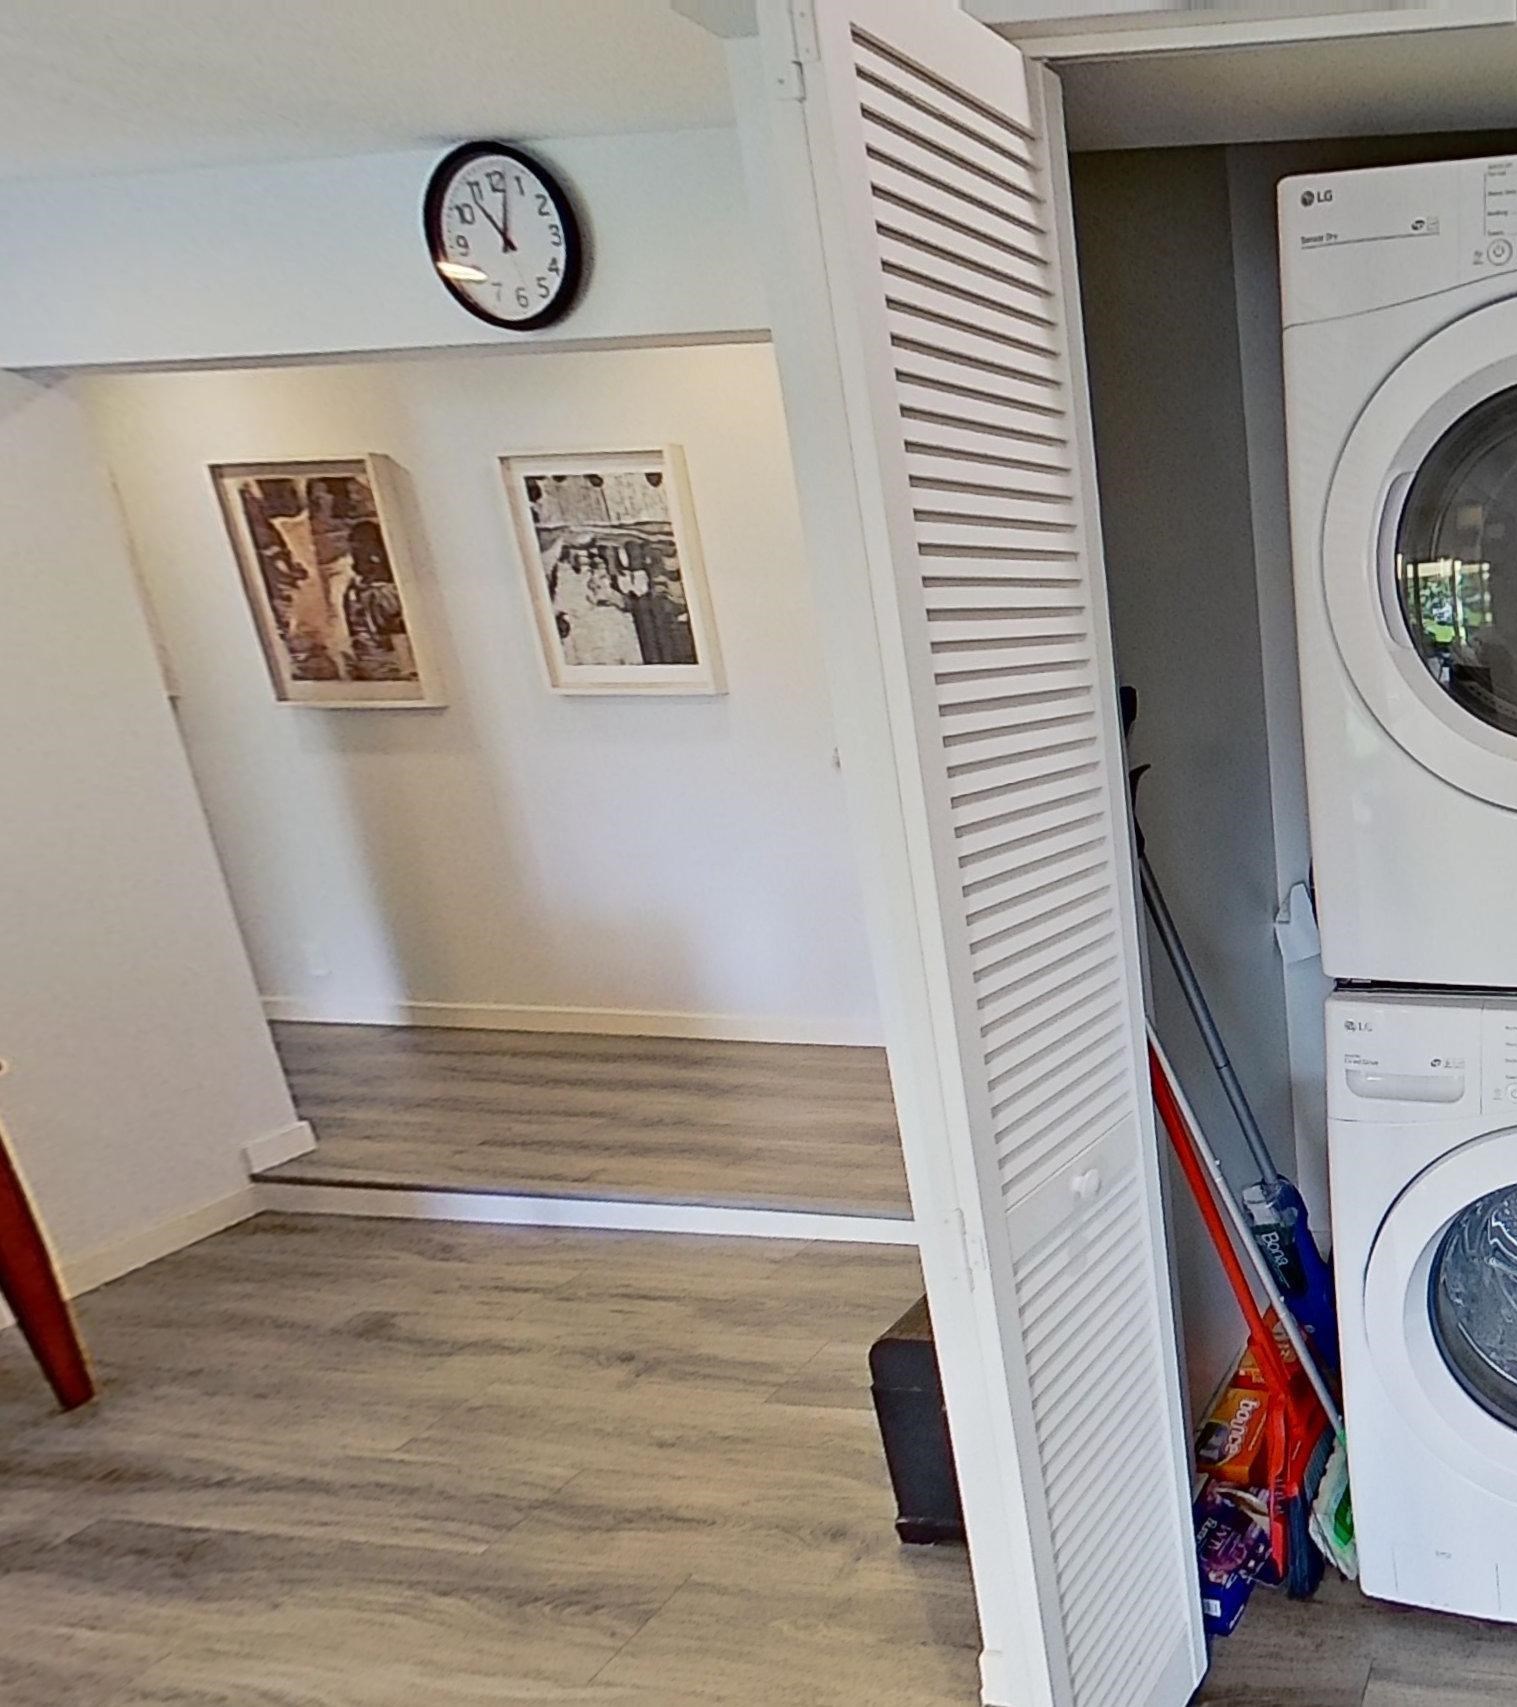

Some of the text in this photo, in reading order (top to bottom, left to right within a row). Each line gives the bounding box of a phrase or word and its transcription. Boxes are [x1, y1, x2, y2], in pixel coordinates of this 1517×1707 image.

[466, 181, 484, 201] 11
[485, 170, 506, 193] 12
[514, 176, 525, 196] 1
[534, 194, 550, 216] 2
[1317, 189, 1333, 203] LG
[454, 203, 475, 225] 10
[456, 235, 470, 256] 9
[548, 224, 562, 246] 3
[547, 257, 560, 275] 4
[491, 282, 503, 302] 7
[515, 287, 529, 308] 6
[536, 277, 550, 298] 5
[1261, 1231, 1289, 1266] Bona
